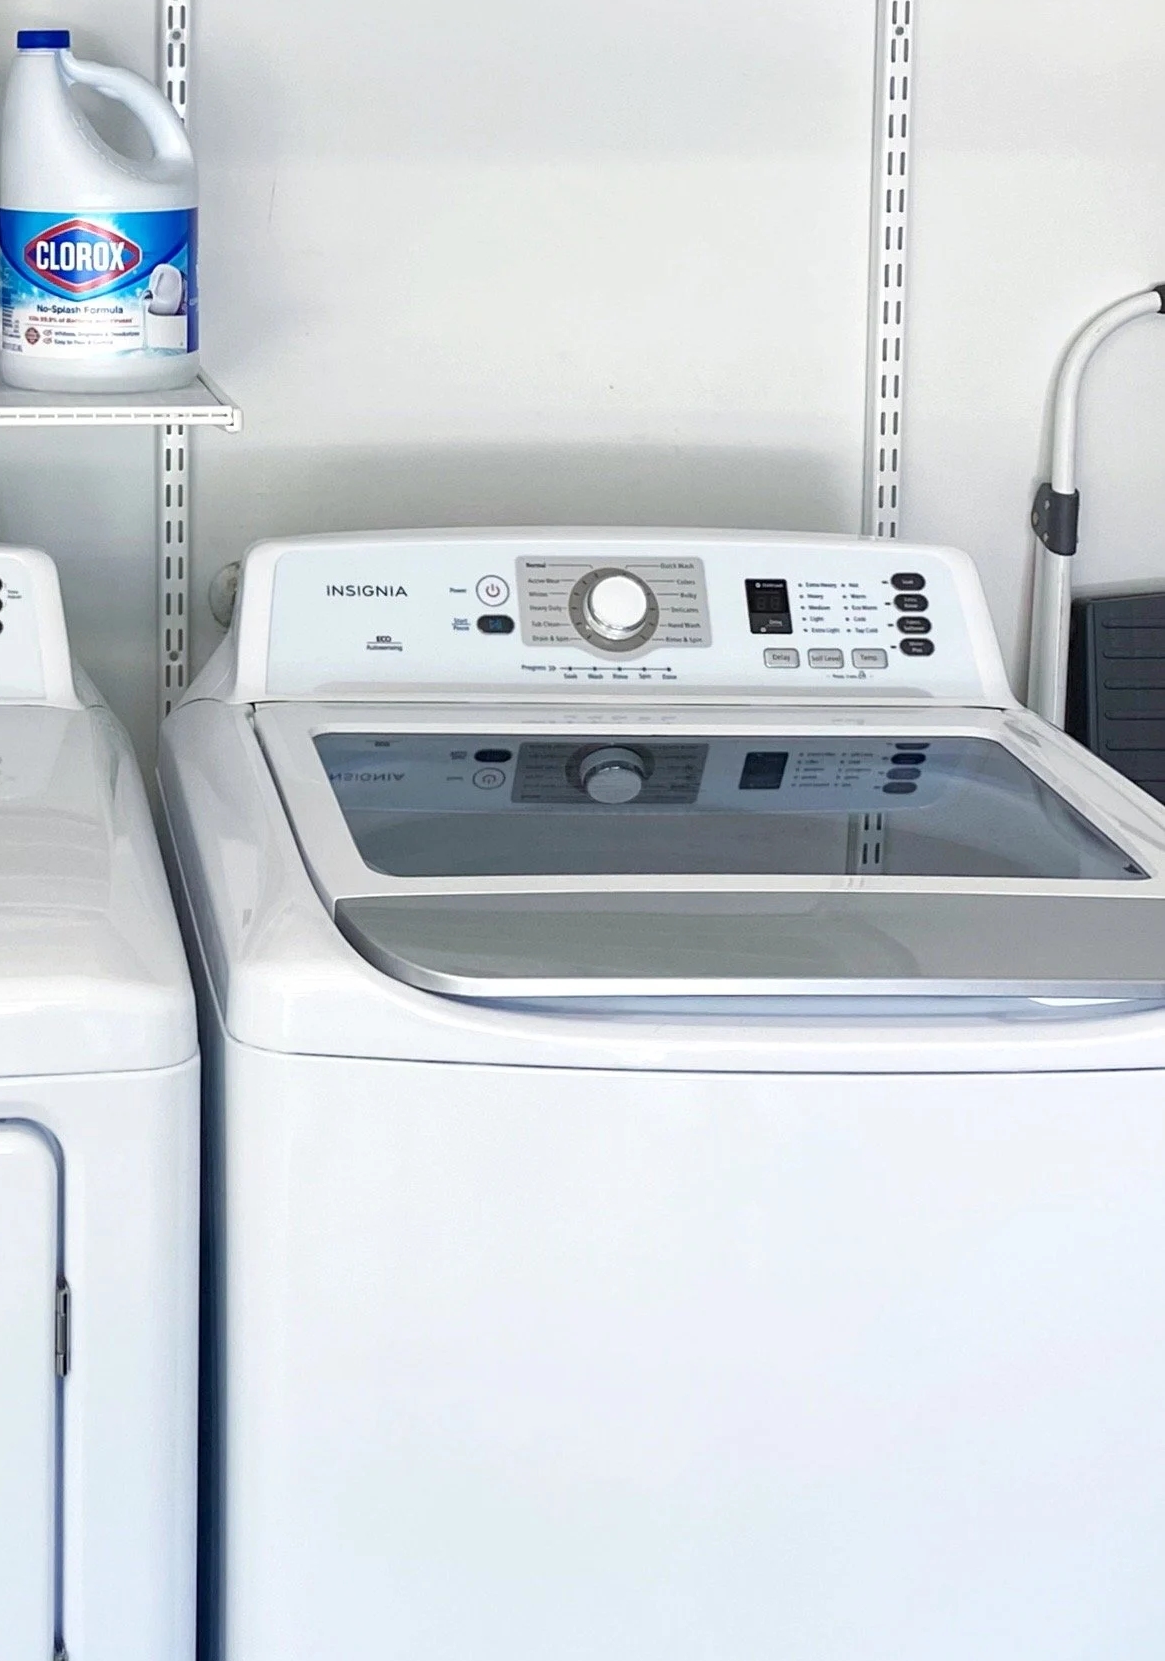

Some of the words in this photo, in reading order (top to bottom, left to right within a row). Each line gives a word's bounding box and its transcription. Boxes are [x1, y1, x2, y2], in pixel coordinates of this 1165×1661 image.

[36, 240, 125, 272] CLOROX
[37, 304, 81, 315] No-Splash
[84, 305, 123, 314] Formula
[327, 585, 408, 597] INSIGNIA
[376, 635, 392, 643] ECO
[366, 644, 403, 652] Autosensing
[772, 653, 790, 662] Delay
